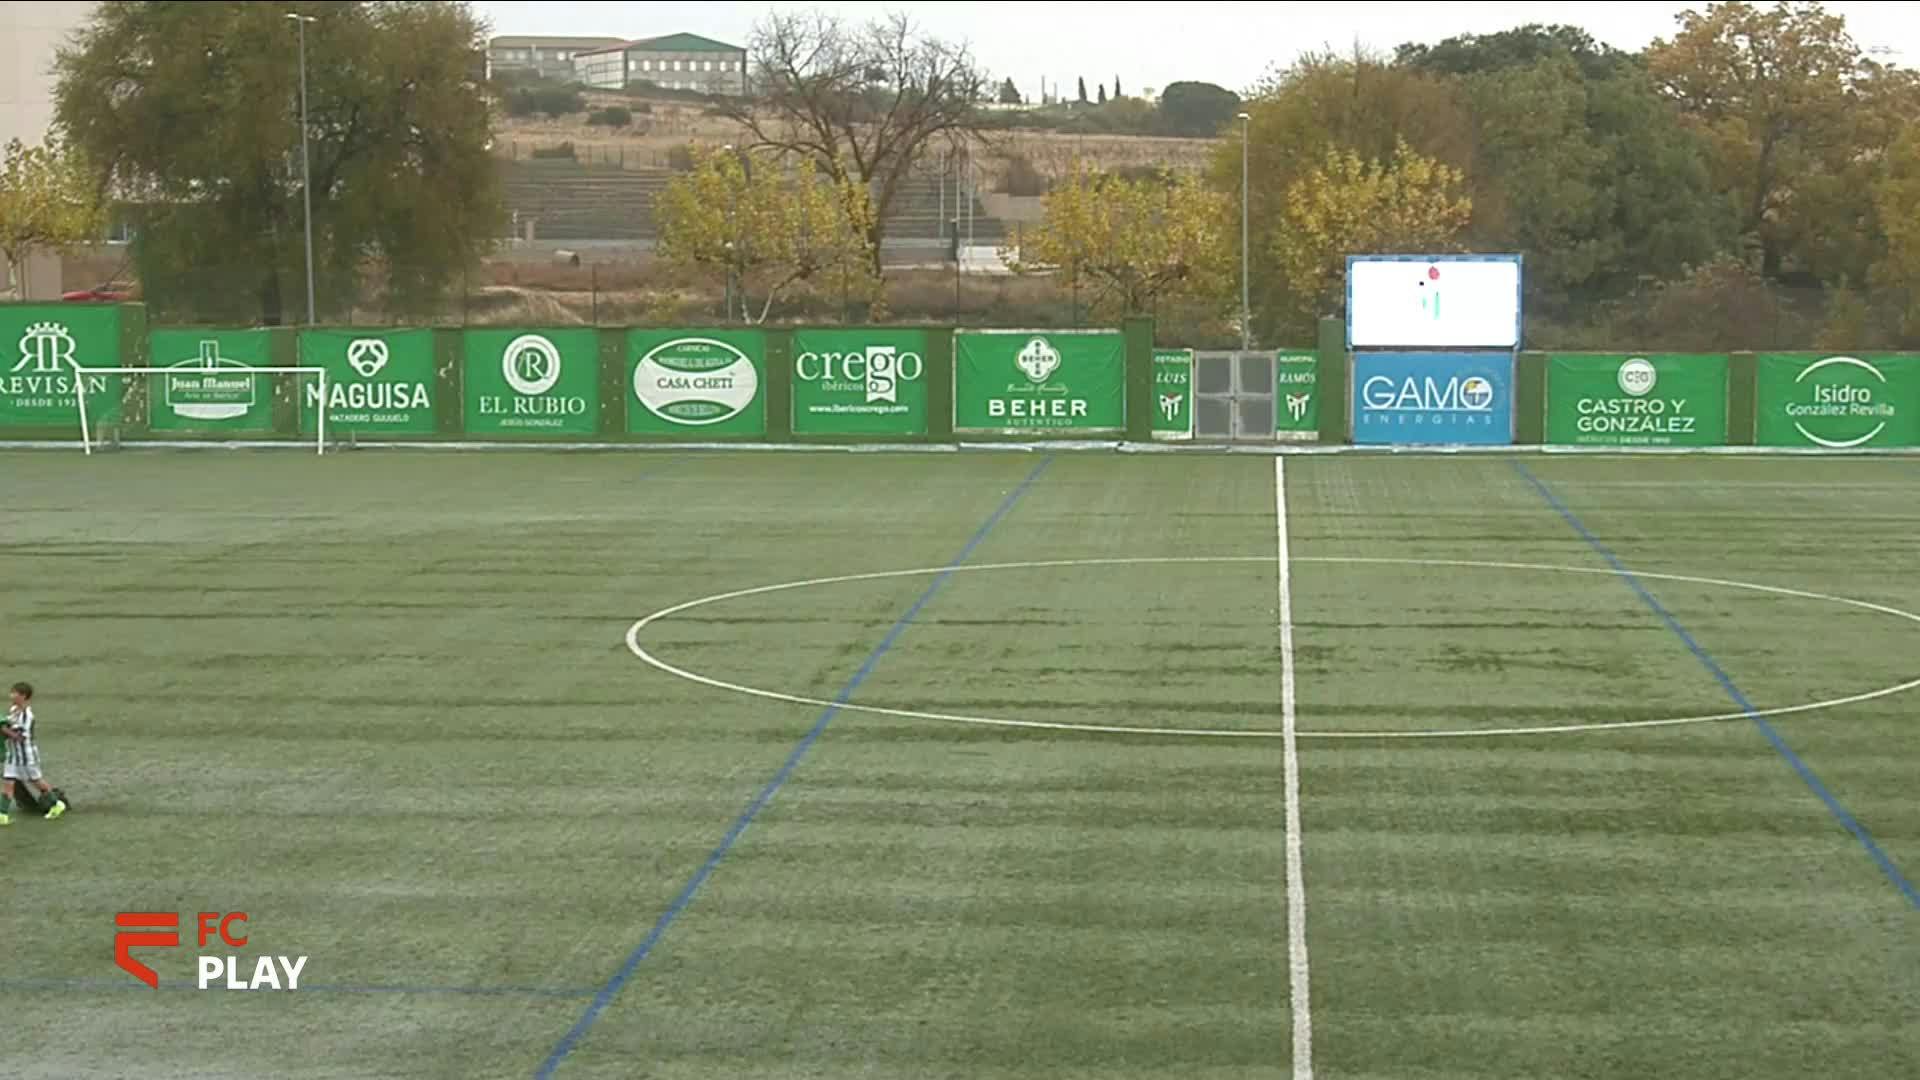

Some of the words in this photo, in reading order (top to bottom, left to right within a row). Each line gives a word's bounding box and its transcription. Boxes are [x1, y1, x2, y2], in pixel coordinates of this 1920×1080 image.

[796, 351, 923, 393] crego
[1156, 372, 1187, 384] LUIS
[171, 377, 200, 391] Juan
[203, 377, 250, 389] Manuel
[657, 378, 691, 388] CASA
[693, 377, 733, 388] CHETI
[306, 383, 430, 408] MAGUISA
[1814, 383, 1871, 403] Isidro
[16, 398, 53, 407] DESDE
[480, 397, 507, 414] EL
[514, 397, 586, 414] RUBIO
[988, 399, 1088, 417] BEHER
[1577, 398, 1665, 414] CASTRO
[1671, 398, 1687, 414] Y
[1849, 402, 1895, 415] Revilla
[1577, 415, 1696, 432] GONZÁLEZ
